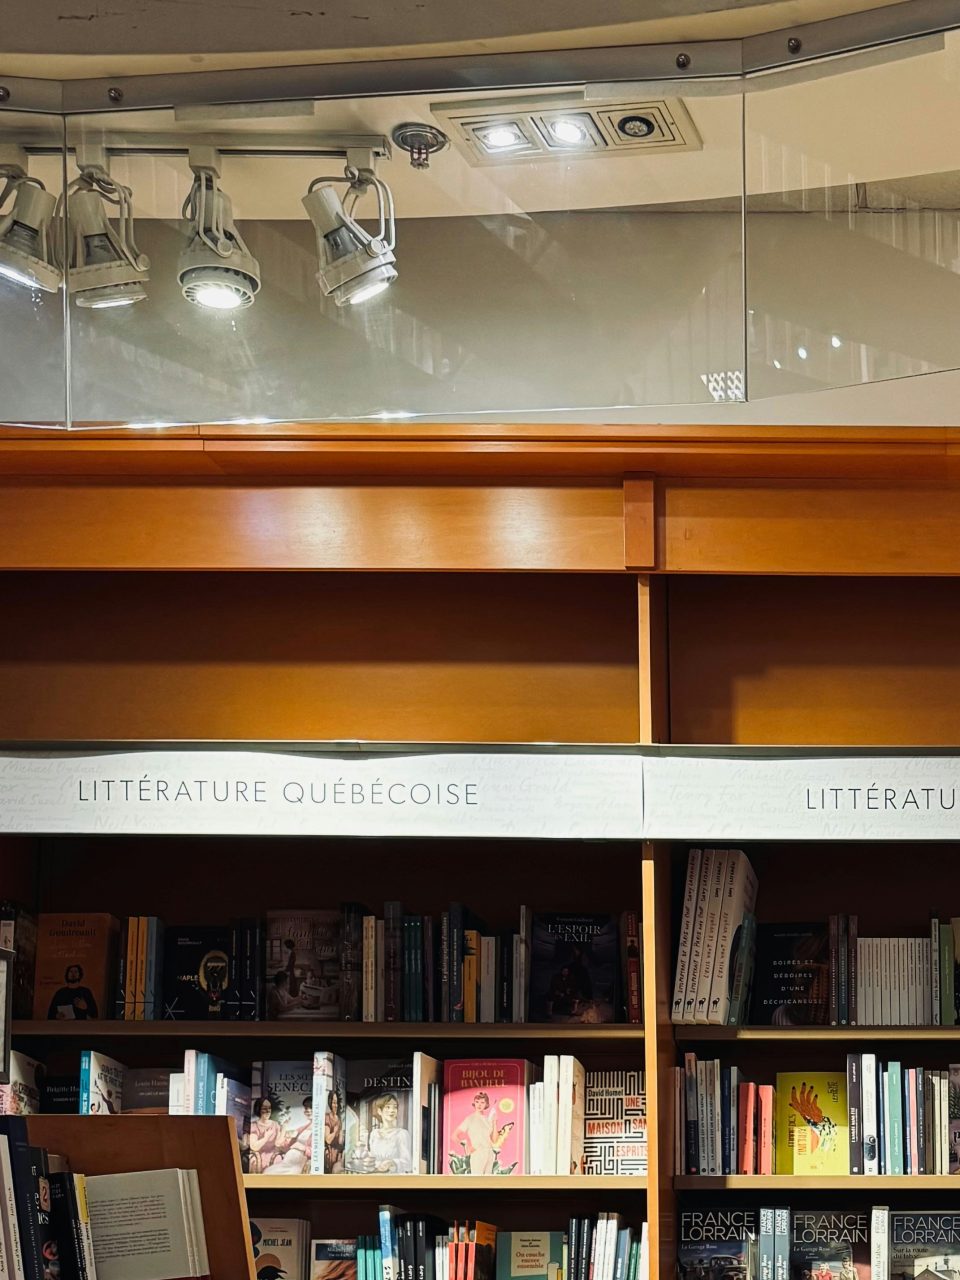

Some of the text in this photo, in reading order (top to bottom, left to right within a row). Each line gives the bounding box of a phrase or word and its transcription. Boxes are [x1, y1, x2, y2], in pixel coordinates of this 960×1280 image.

[78, 775, 479, 806] LITTÉRATURE QUÉBÉCOISE
[363, 1076, 414, 1088] DESTIN
[625, 1097, 641, 1108] UNE
[587, 1120, 623, 1136] MAISON
[681, 1212, 756, 1227] FRANCE
[793, 1215, 868, 1229] FRANCE
[681, 1226, 756, 1241] LORRAIN
[793, 1229, 868, 1243] LORRAIN
